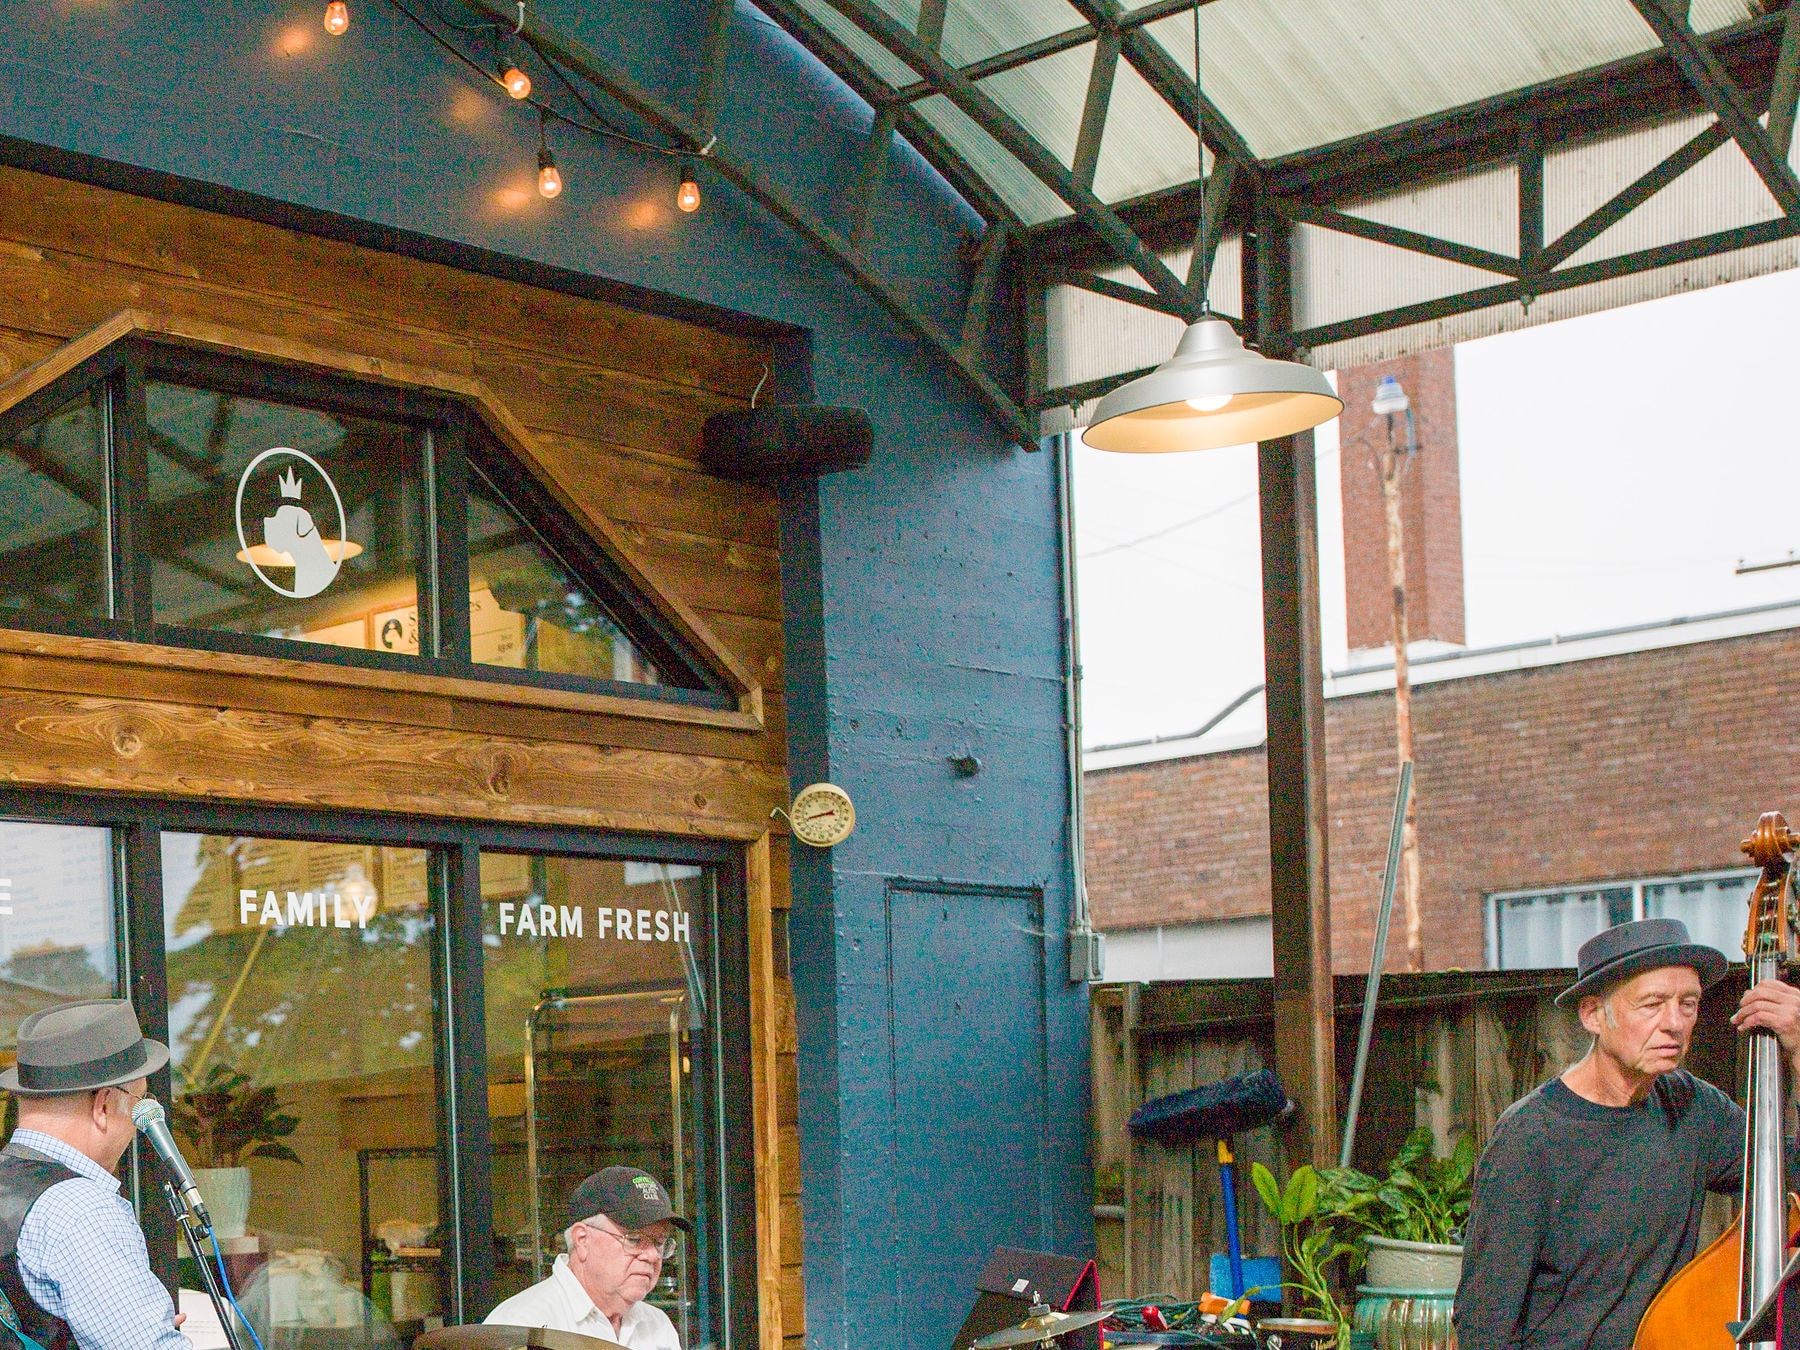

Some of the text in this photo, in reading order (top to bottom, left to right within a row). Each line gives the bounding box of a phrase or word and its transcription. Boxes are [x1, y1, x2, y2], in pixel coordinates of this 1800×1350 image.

[240, 889, 374, 929] FAMILY
[499, 902, 691, 943] FARM FRESH
